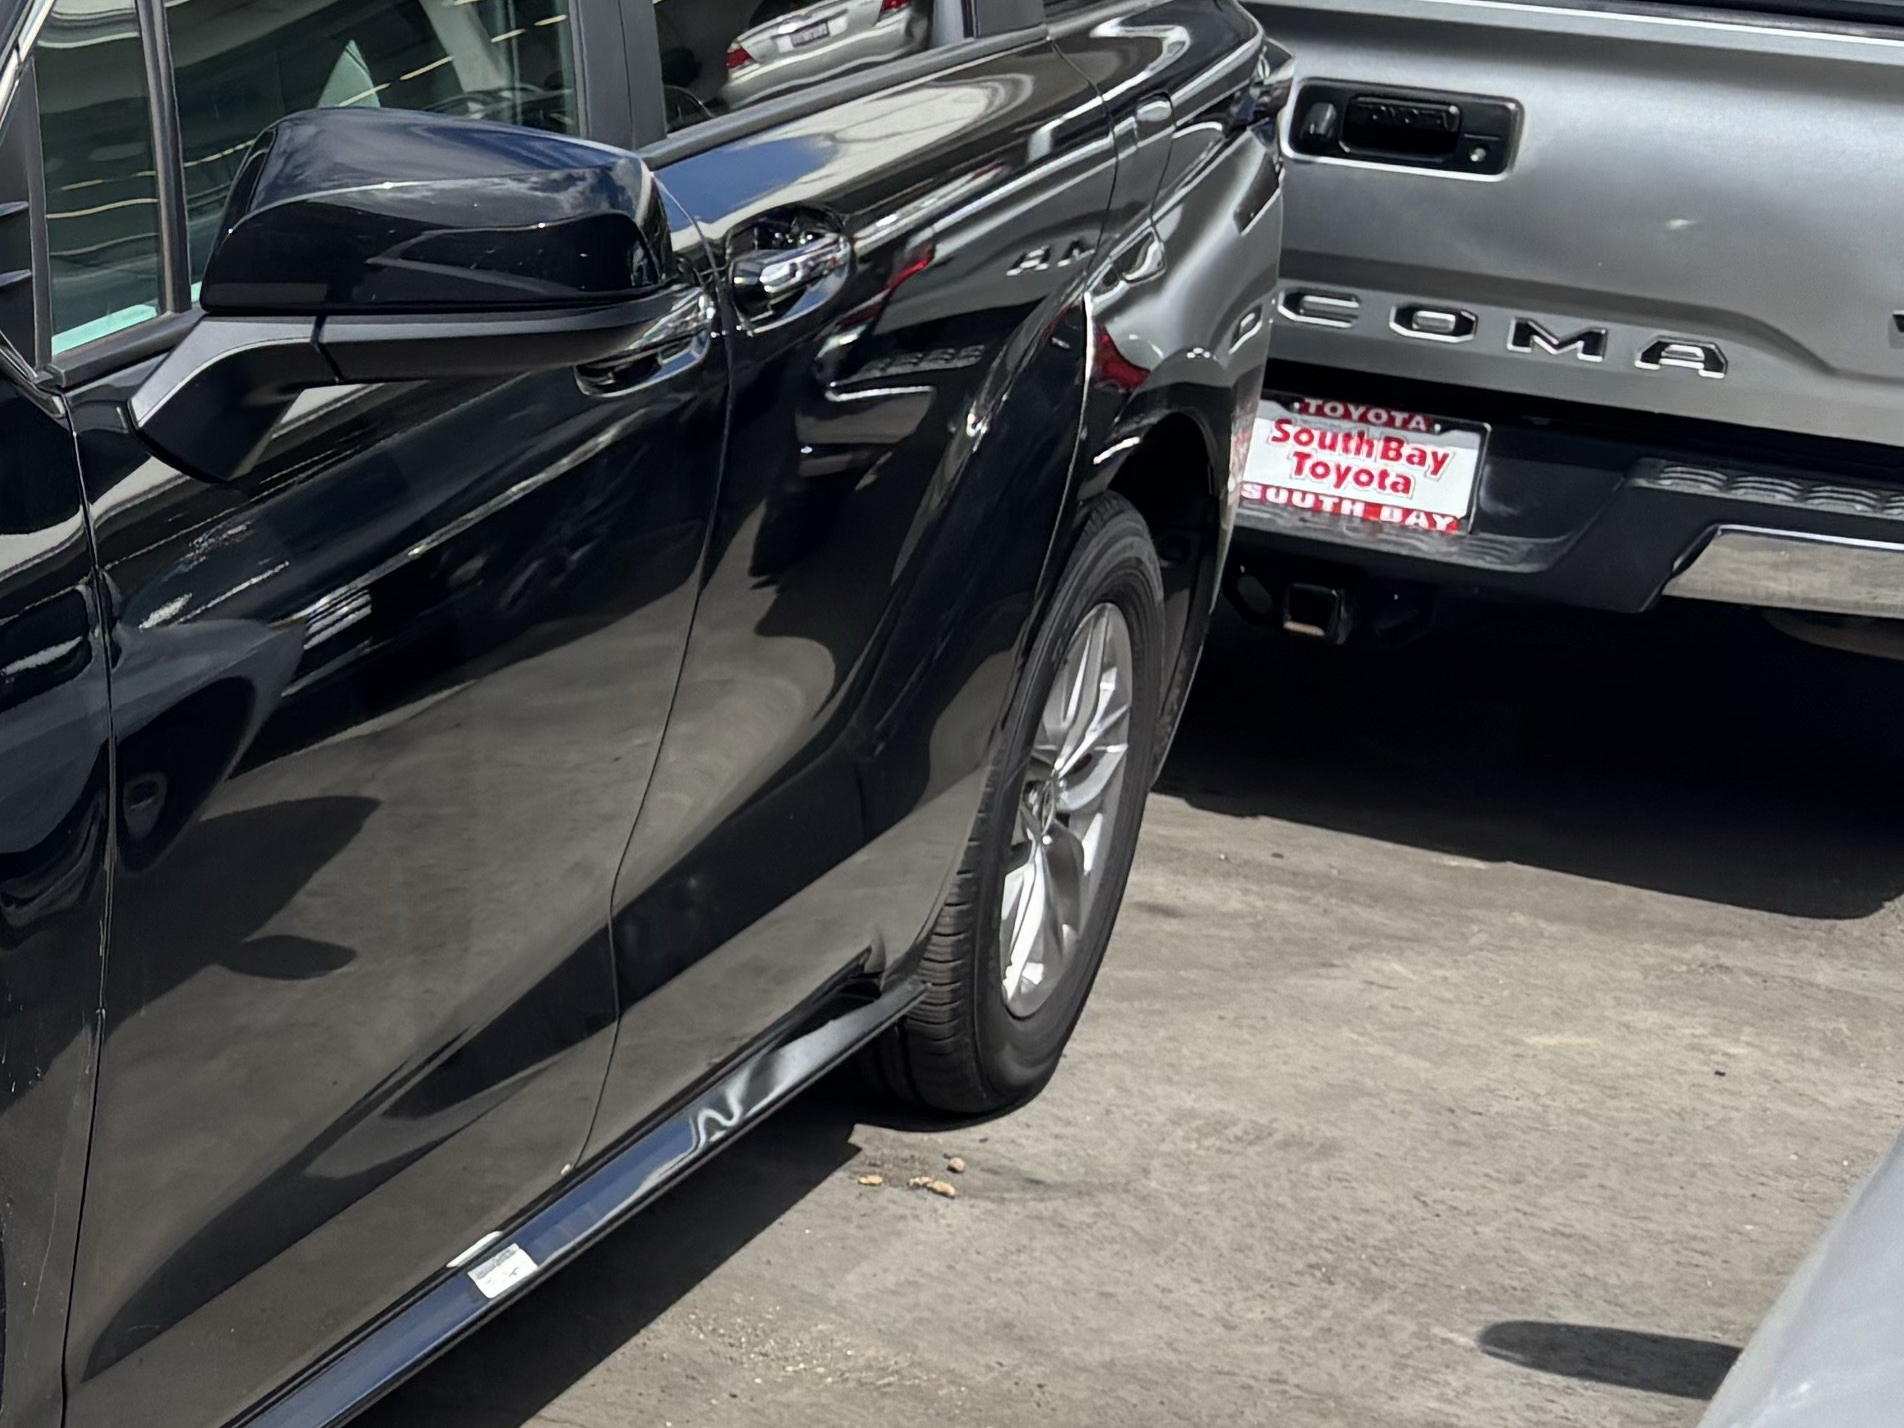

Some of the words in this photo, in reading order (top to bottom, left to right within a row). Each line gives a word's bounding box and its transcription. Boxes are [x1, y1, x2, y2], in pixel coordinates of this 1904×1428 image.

[1303, 398, 1428, 432] TOYOTA
[1293, 451, 1413, 496] Toyota
[1241, 483, 1365, 517] SOUTH
[1379, 505, 1457, 532] BAY
